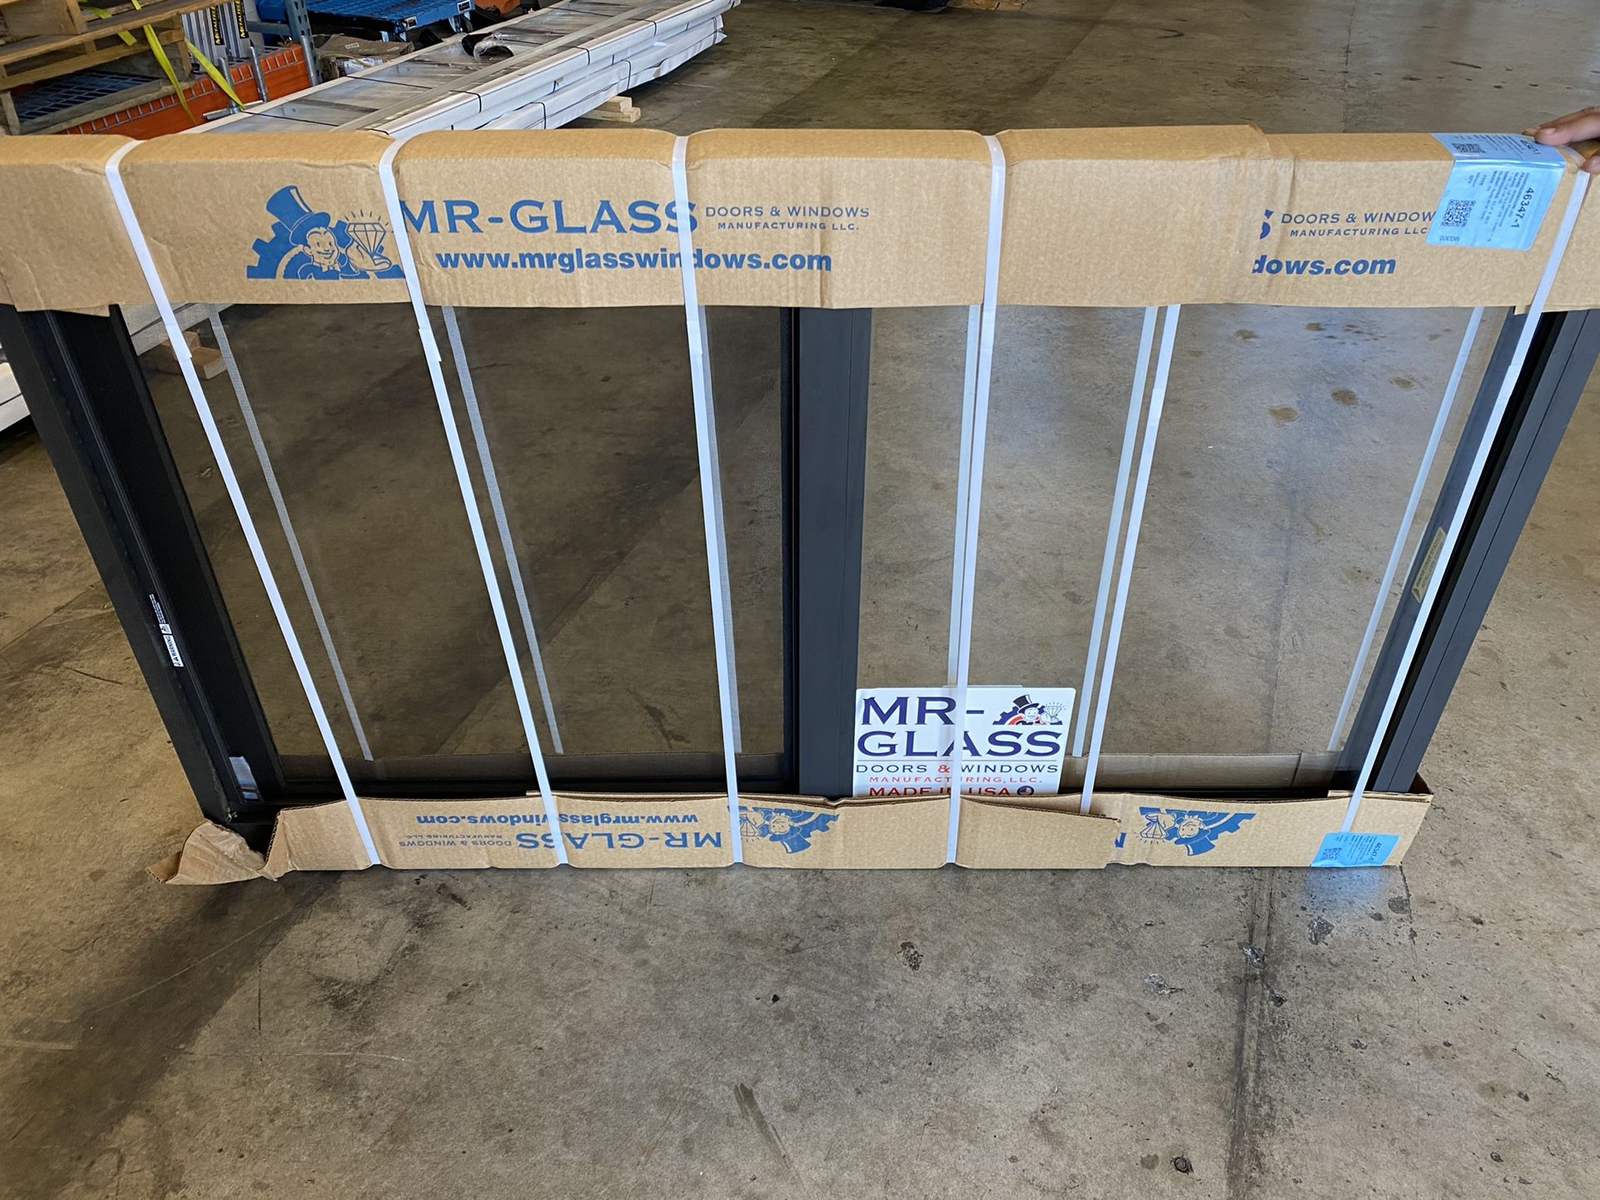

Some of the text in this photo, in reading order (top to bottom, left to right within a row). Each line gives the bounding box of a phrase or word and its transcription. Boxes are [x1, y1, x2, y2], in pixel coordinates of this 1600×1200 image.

[1510, 187, 1534, 228] 46347-1
[398, 199, 870, 234] MR-GLASS DOORS & WINDOWS
[1281, 212, 1341, 224] DOORS
[1346, 212, 1357, 223] &
[718, 221, 826, 231] MANUFACTURING
[1290, 228, 1399, 238] MANUFACTURING
[861, 696, 985, 725] MR-
[857, 730, 1062, 757] GLASS
[856, 764, 928, 773] DOORS
[961, 764, 1058, 773] WINDOWS
[869, 786, 932, 796] MADE
[399, 840, 457, 848] WINDOWS
[472, 840, 512, 848] DOORS
[515, 831, 722, 849] MR-GLASS
